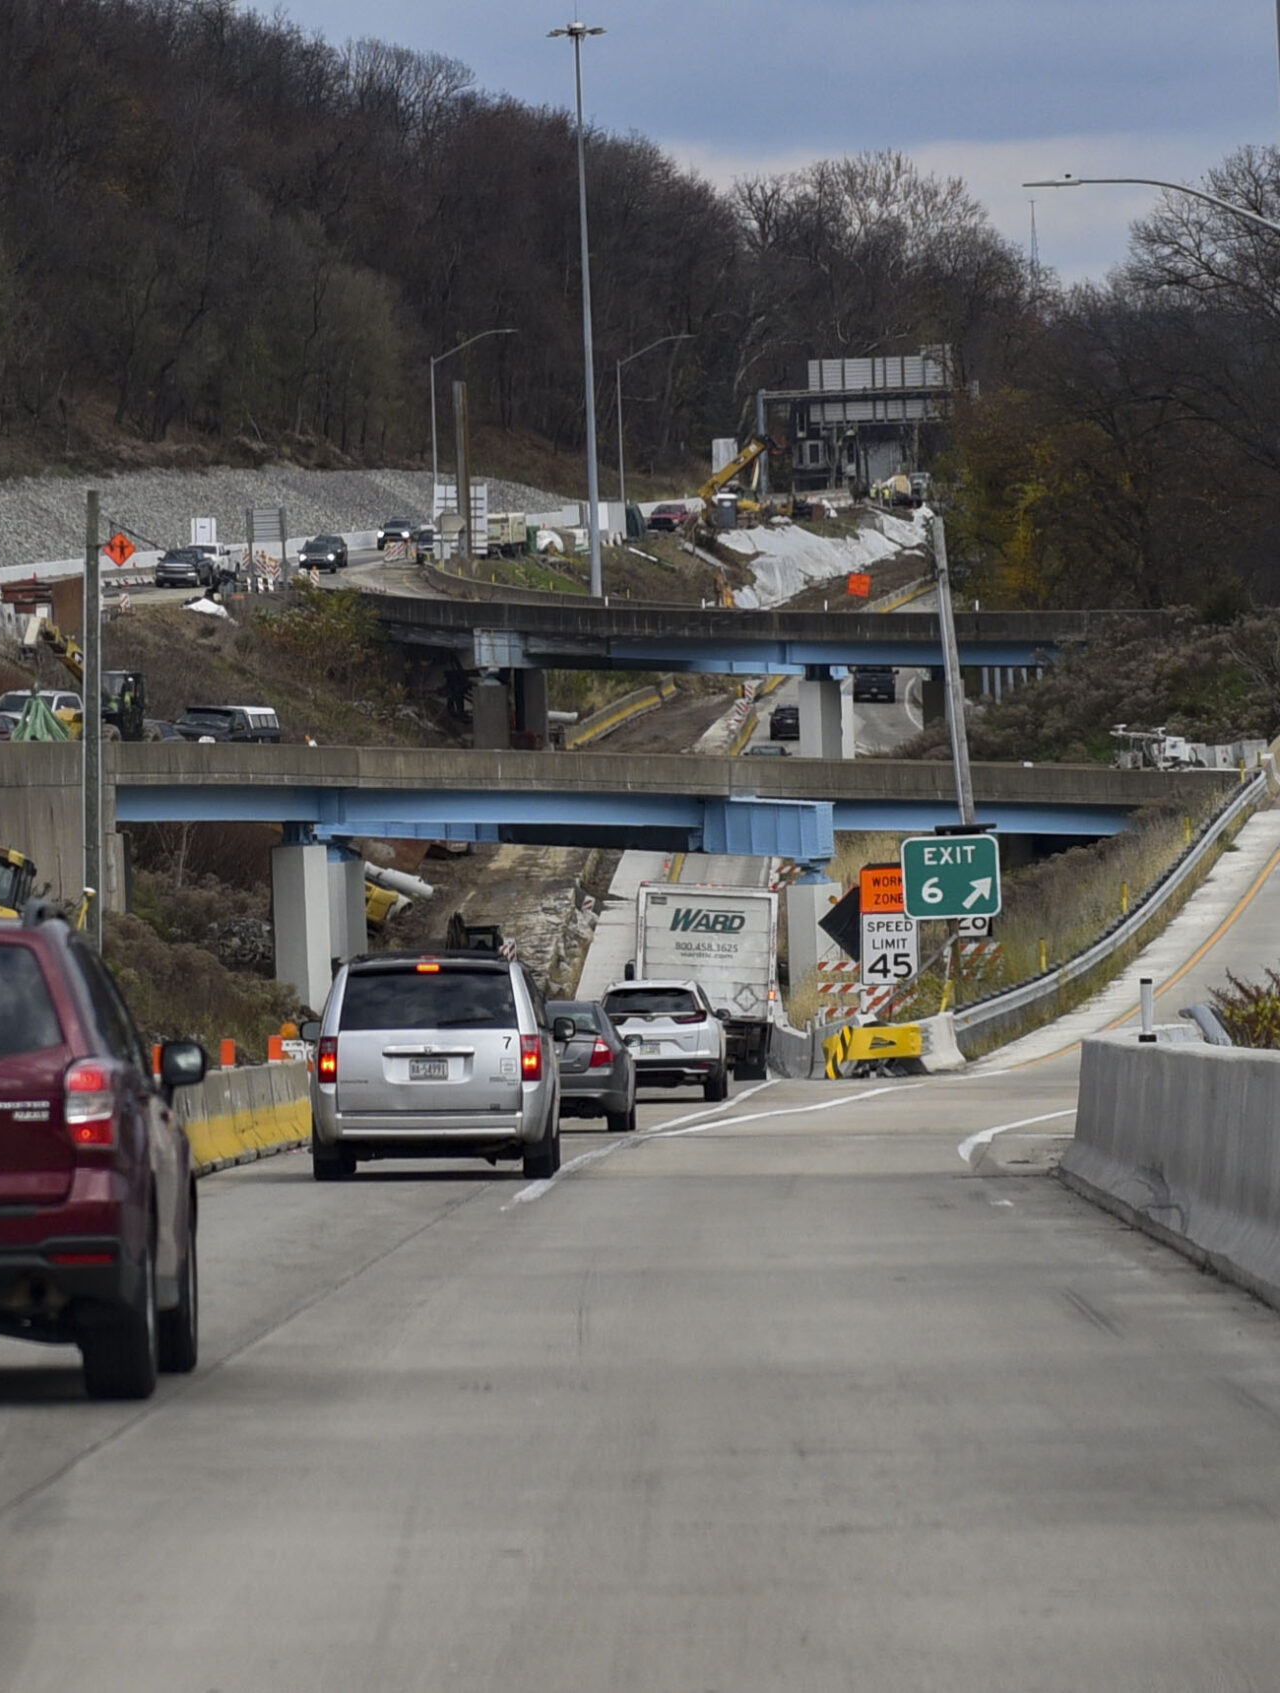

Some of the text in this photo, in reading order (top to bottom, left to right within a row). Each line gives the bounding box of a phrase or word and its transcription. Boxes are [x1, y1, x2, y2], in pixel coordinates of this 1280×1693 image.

[923, 846, 976, 866] EXIT
[921, 877, 943, 904] 6
[874, 893, 904, 906] ZONE
[669, 908, 746, 934] WARD
[866, 920, 913, 933] SPEED
[872, 938, 908, 951] LIMIT
[867, 953, 913, 979] 45
[503, 1036, 512, 1050] 7
